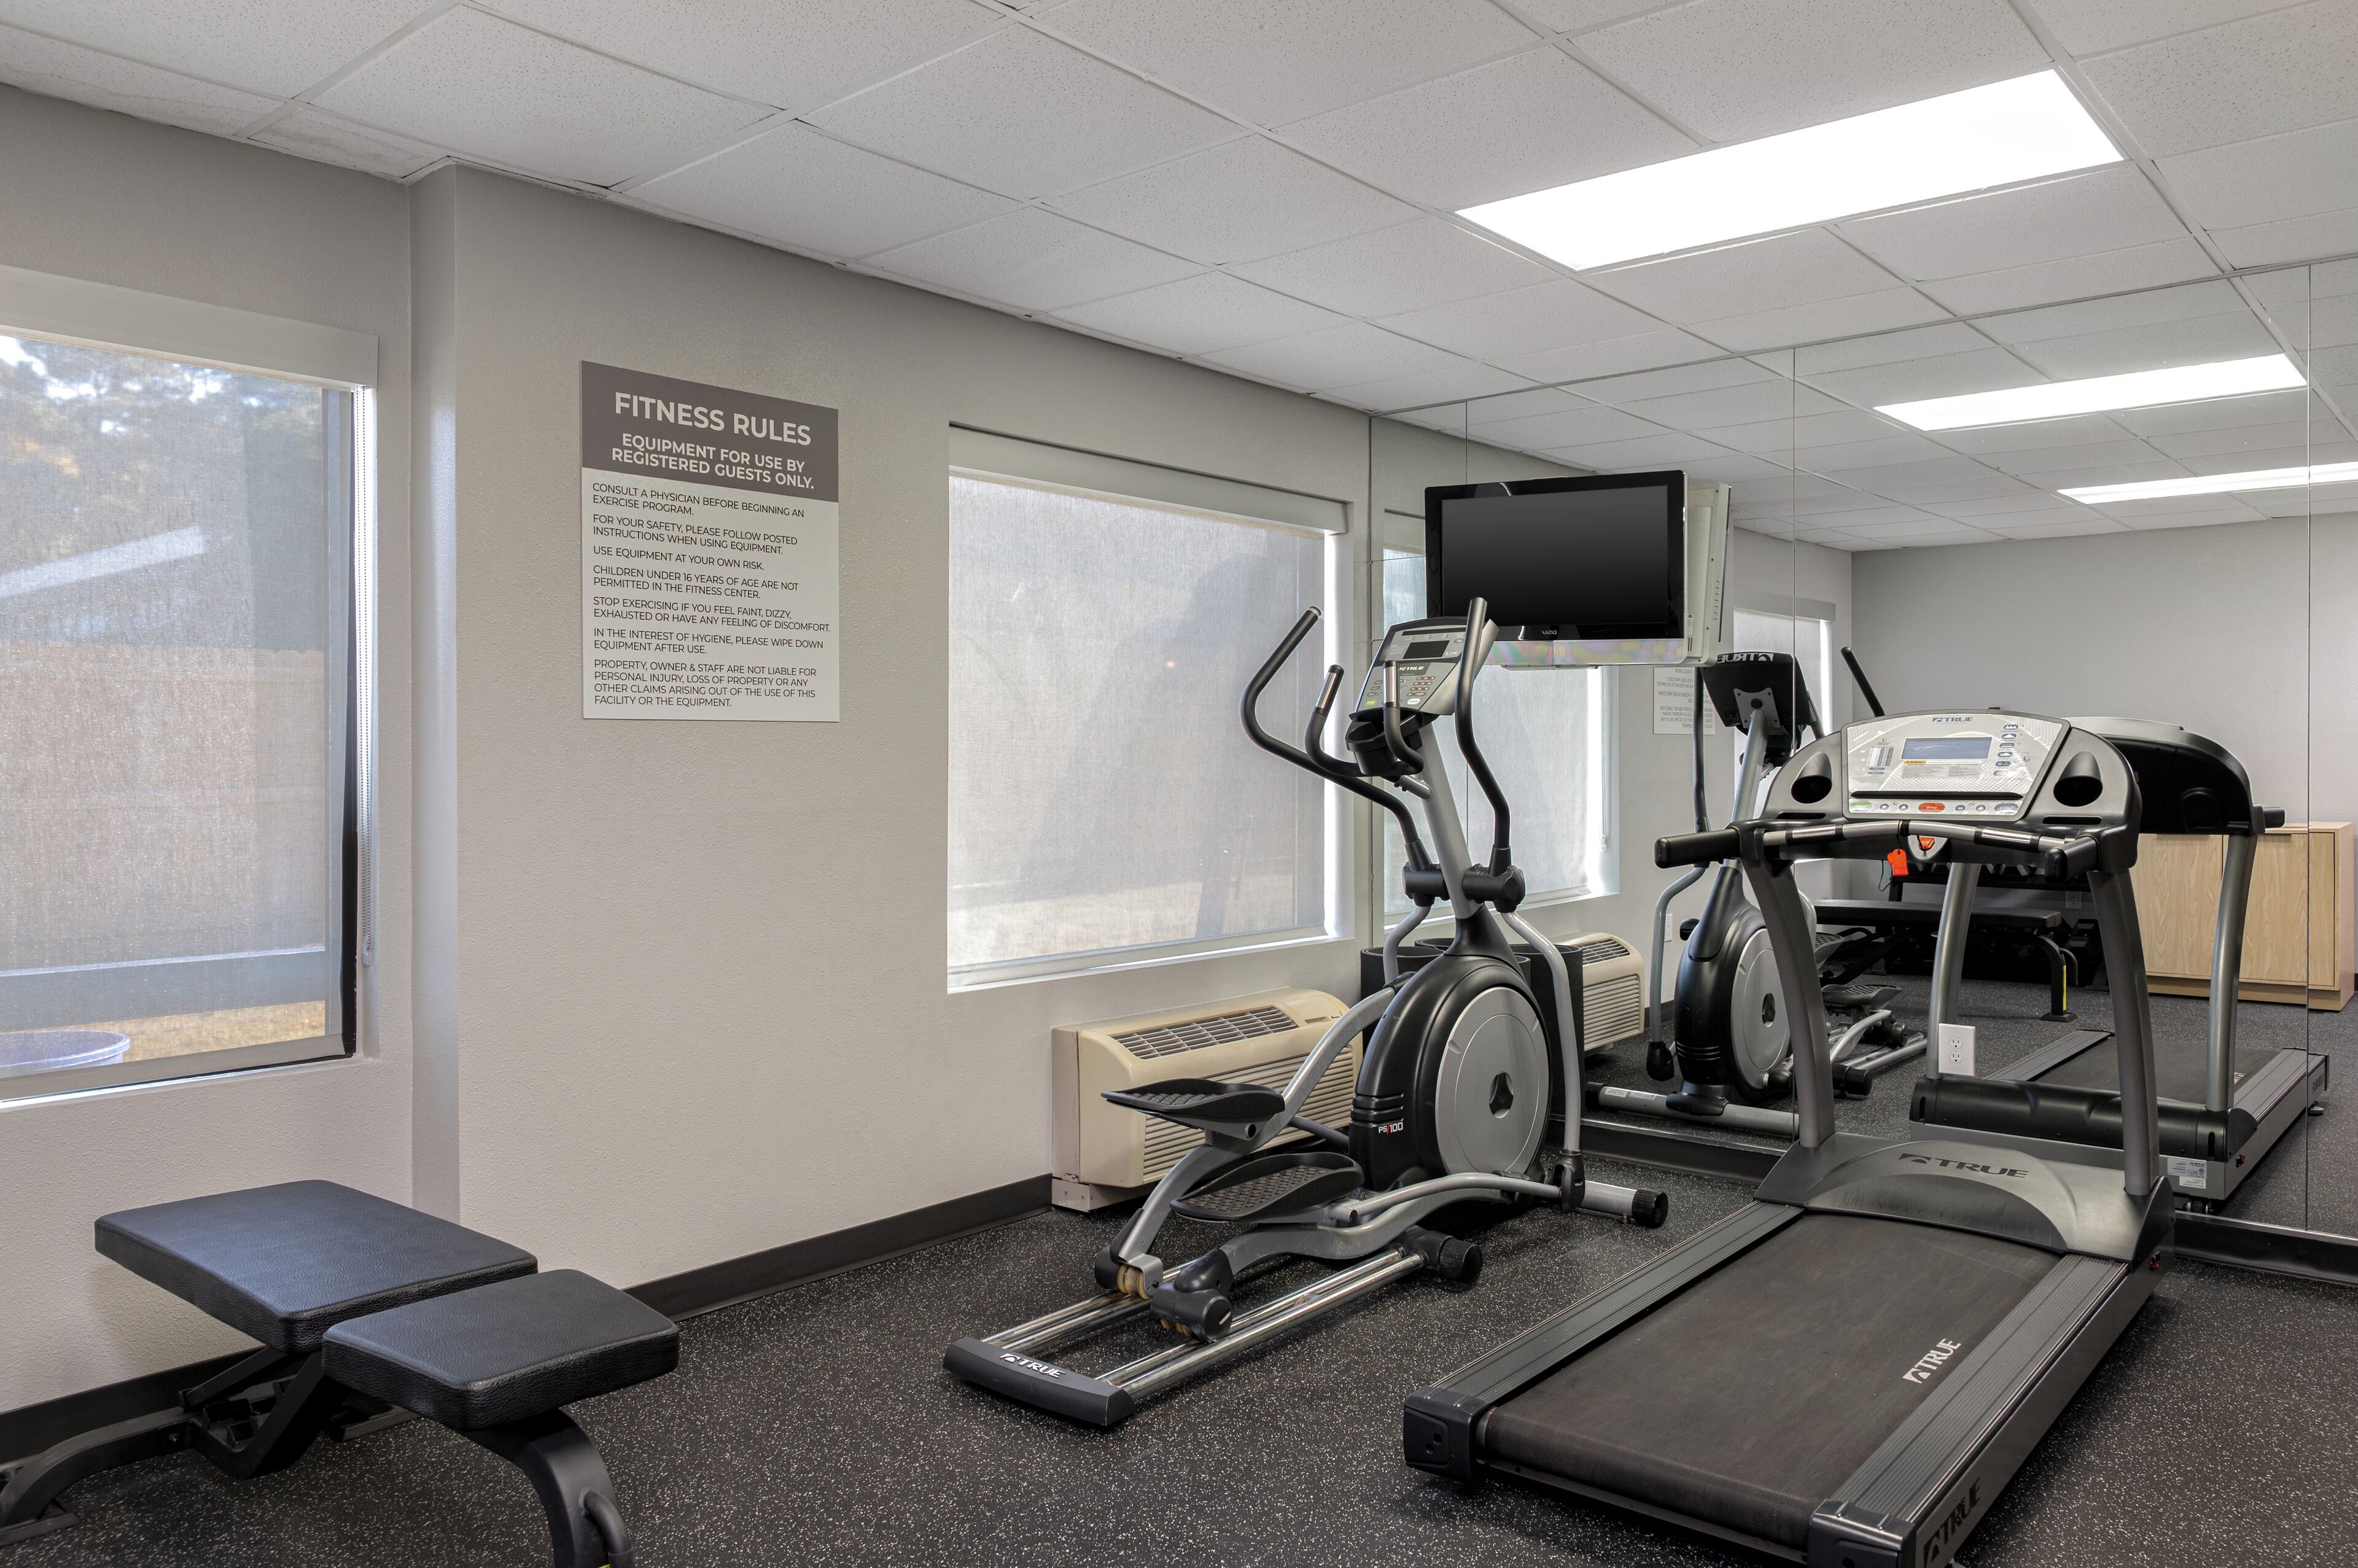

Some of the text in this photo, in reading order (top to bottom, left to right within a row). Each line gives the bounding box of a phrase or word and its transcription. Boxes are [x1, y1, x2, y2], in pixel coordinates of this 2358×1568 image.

[615, 391, 811, 446] FITNESS RULES
[622, 432, 805, 473] EQUIPMENT FOR USE BY
[612, 447, 814, 489] REGISTERED GUESTS ONLY.
[592, 482, 804, 518] CONSULT A PHYSICIAN BEFORE BEGINNING AN
[593, 494, 694, 516] EXERCISE PROGRAM.
[593, 513, 798, 545] FOR YOUR SAFETY, PLEASE FOLLOW POSTED
[593, 526, 783, 554] INSTRUCTIONS WHEN USING EQUIPMENT.
[593, 545, 765, 570] USE EQUIPMENT AT YOUR OWN RISK.
[593, 564, 799, 591] CHILDREN UNDER 16 YEARS OF AGE ARE NOT
[593, 576, 761, 599] PERMITTED IN THE FITNESS CENTER.
[593, 596, 792, 620] STOP EXERCISING IF YOU FEEL FAINT, DIZZY,
[594, 608, 830, 632] EXHAUSTED OR HAVE ANY FEELING OF DISCOMFORT.
[594, 627, 823, 649] IN THE INTEREST OF HYGIENE, PLEASE WIPE DOWN
[594, 639, 707, 654] EQUIPMENT AFTER USE.
[594, 659, 816, 677] PROPERTY, OWNER & STAFF ARE NOT LIABLE FOR
[594, 670, 809, 687] PERSONAL INJURY, LOSS OF PROPERTY OR ANY
[594, 683, 815, 698] OTHER CLAIMS ARISING OUT OF THE USE OF THIS
[594, 695, 731, 707] FACILITY OR THE EQUIPMENT.
[1378, 1122, 1403, 1135] PS/100
[1935, 1158, 2029, 1178] TRUE
[1913, 1338, 1961, 1370] TRUE
[1018, 1359, 1066, 1378] TRUE
[1940, 1477, 1980, 1545] TRUE
